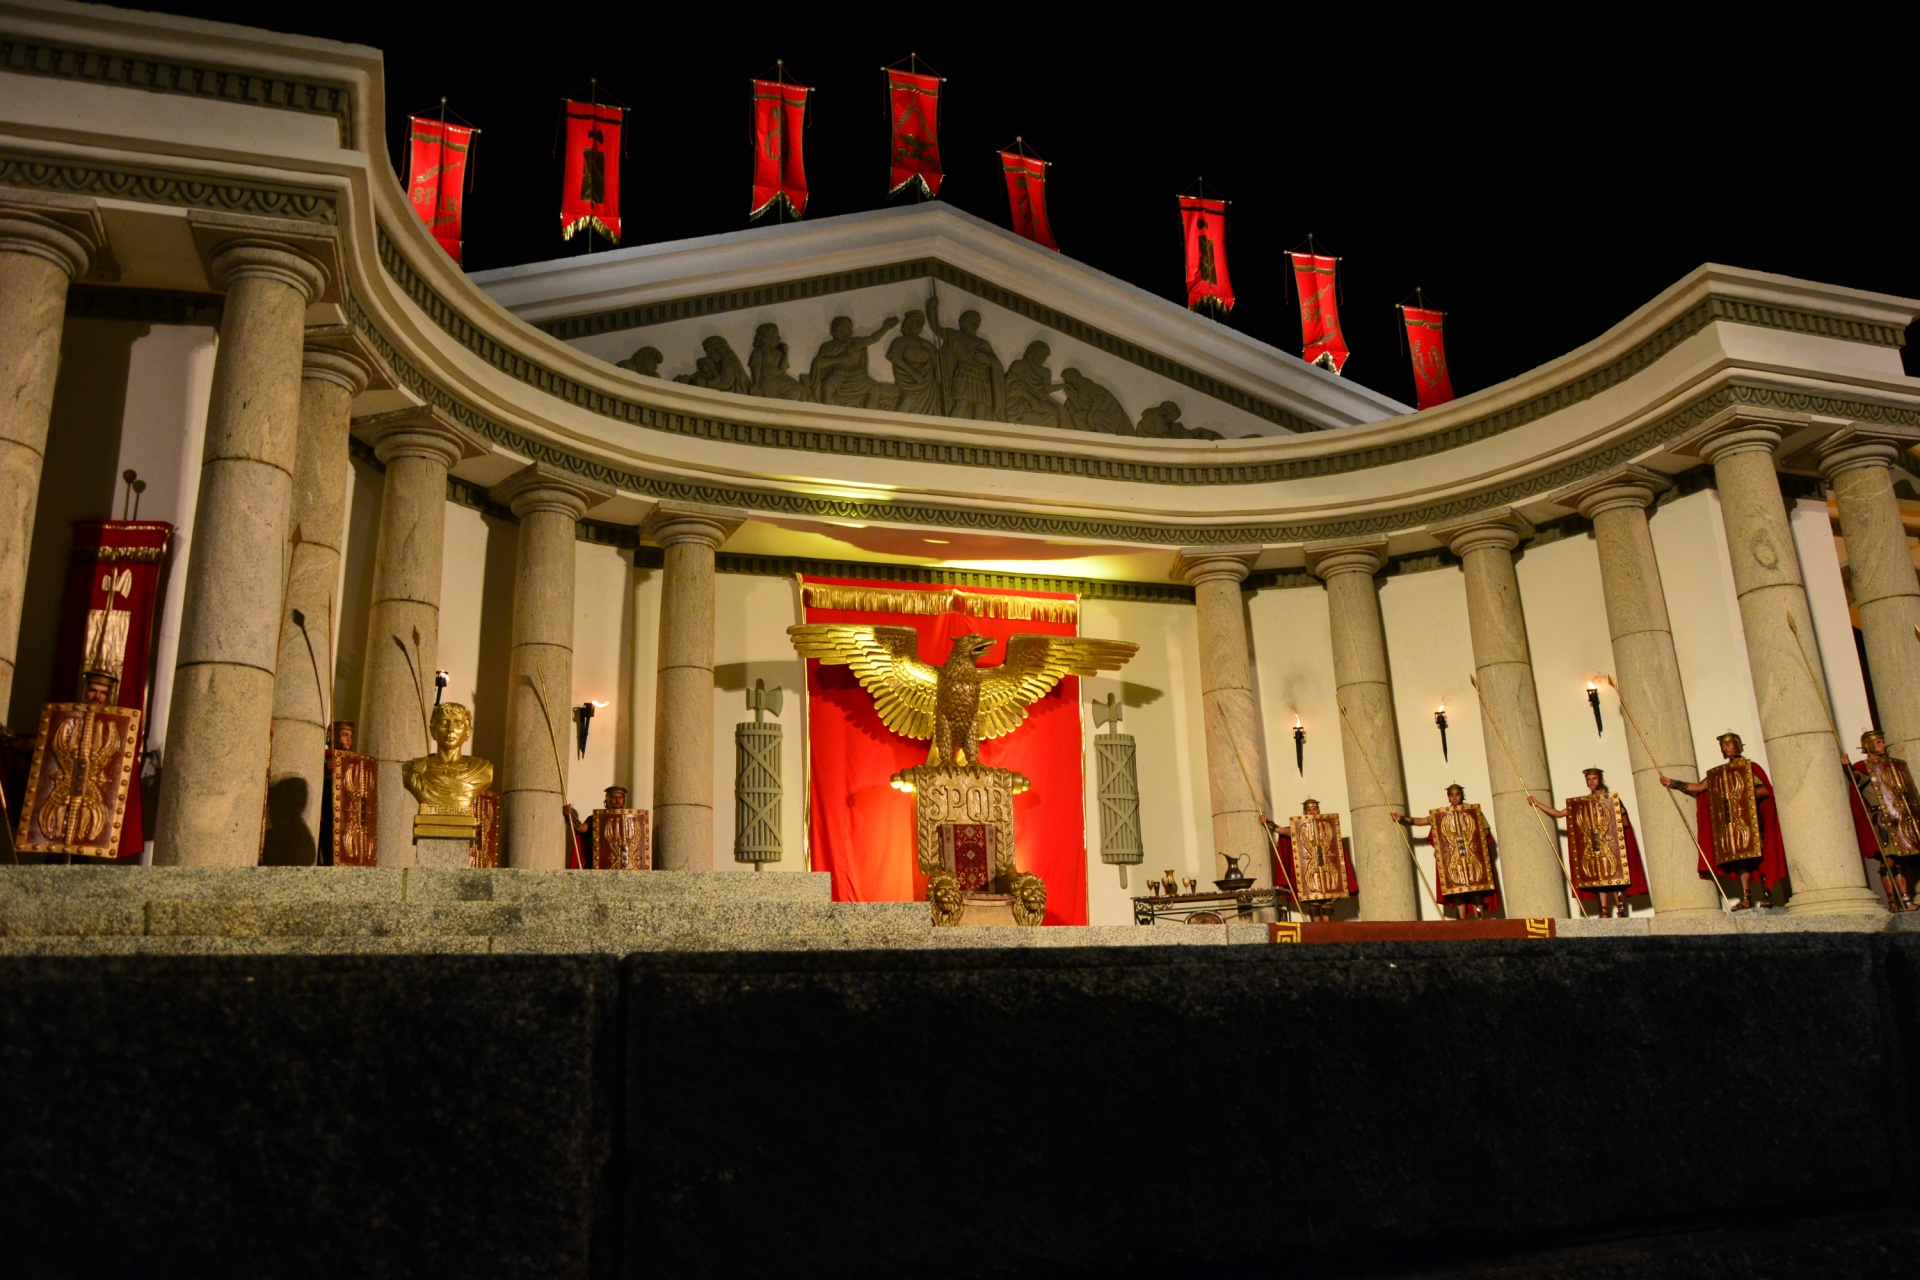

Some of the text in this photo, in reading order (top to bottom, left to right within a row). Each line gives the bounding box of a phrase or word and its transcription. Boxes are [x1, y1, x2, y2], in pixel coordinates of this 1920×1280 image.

[412, 187, 458, 214] SPR
[428, 805, 468, 814] TIBERIUS
[925, 785, 1010, 824] SPQR
